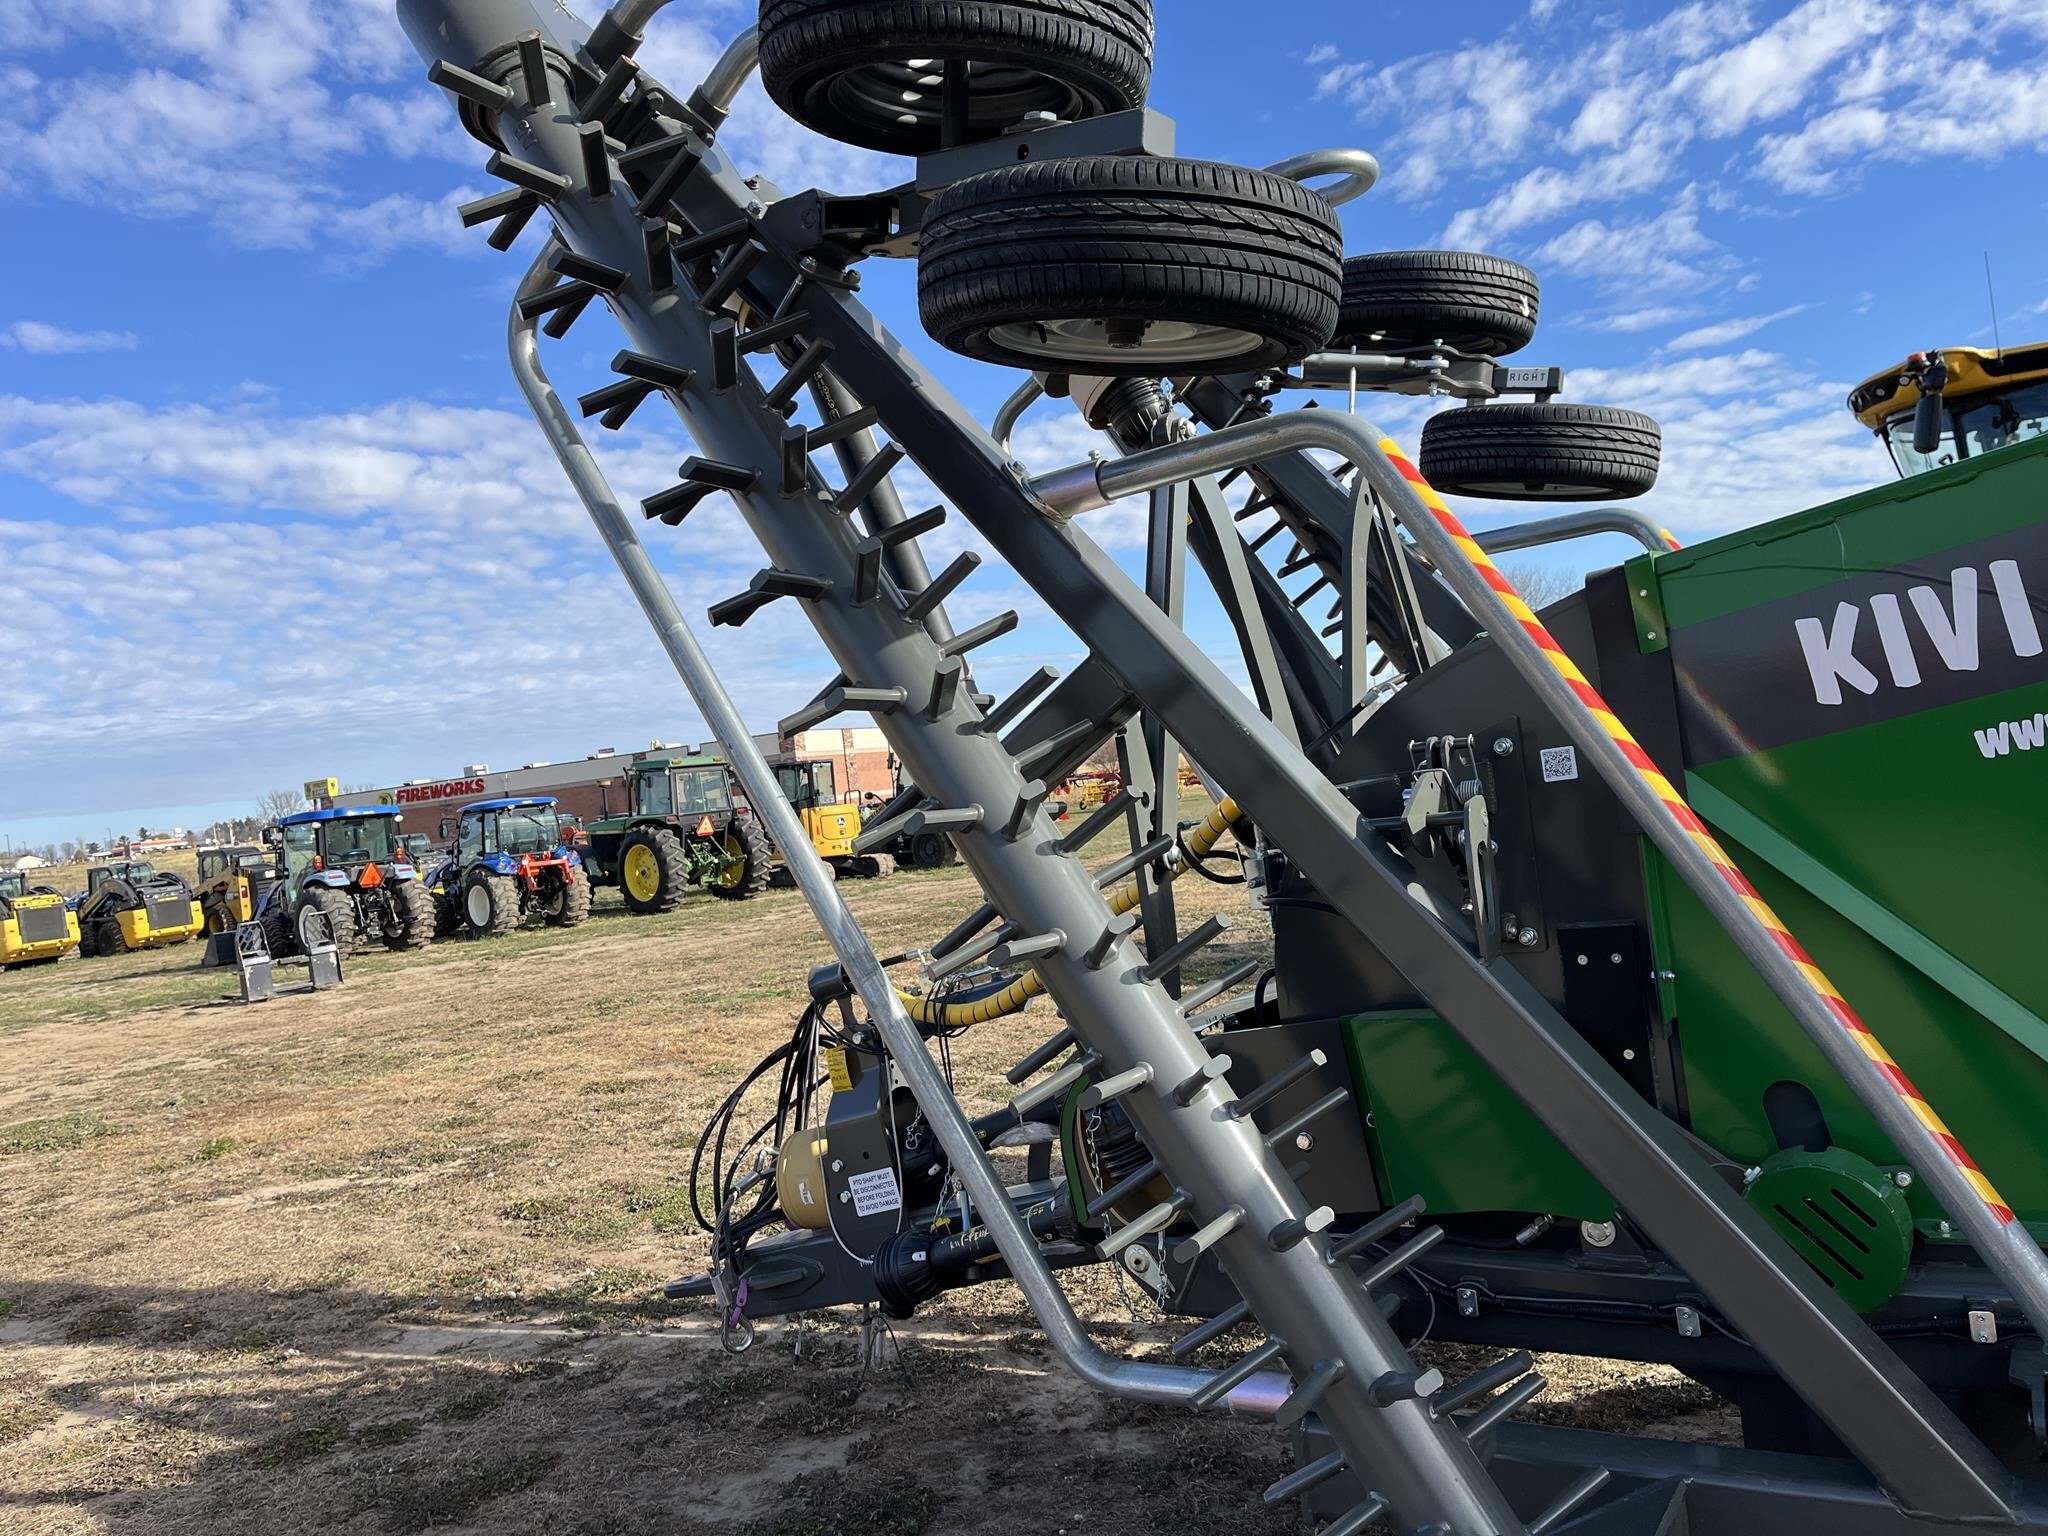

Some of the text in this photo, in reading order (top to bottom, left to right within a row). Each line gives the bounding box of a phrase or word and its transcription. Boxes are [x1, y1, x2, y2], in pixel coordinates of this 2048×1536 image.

[1510, 373, 1546, 381] RIGHT
[1795, 559, 2043, 705] KIVI
[1973, 713, 2048, 759] ww
[396, 778, 485, 803] FIREWORKS
[853, 1172, 890, 1186] PTO SHAFT MUST
[860, 1180, 895, 1194] DISCONNECTED
[857, 1189, 896, 1204] BEFORE FOLDING
[865, 1202, 879, 1211] AVOID
[879, 1197, 899, 1208] DAMAGE
